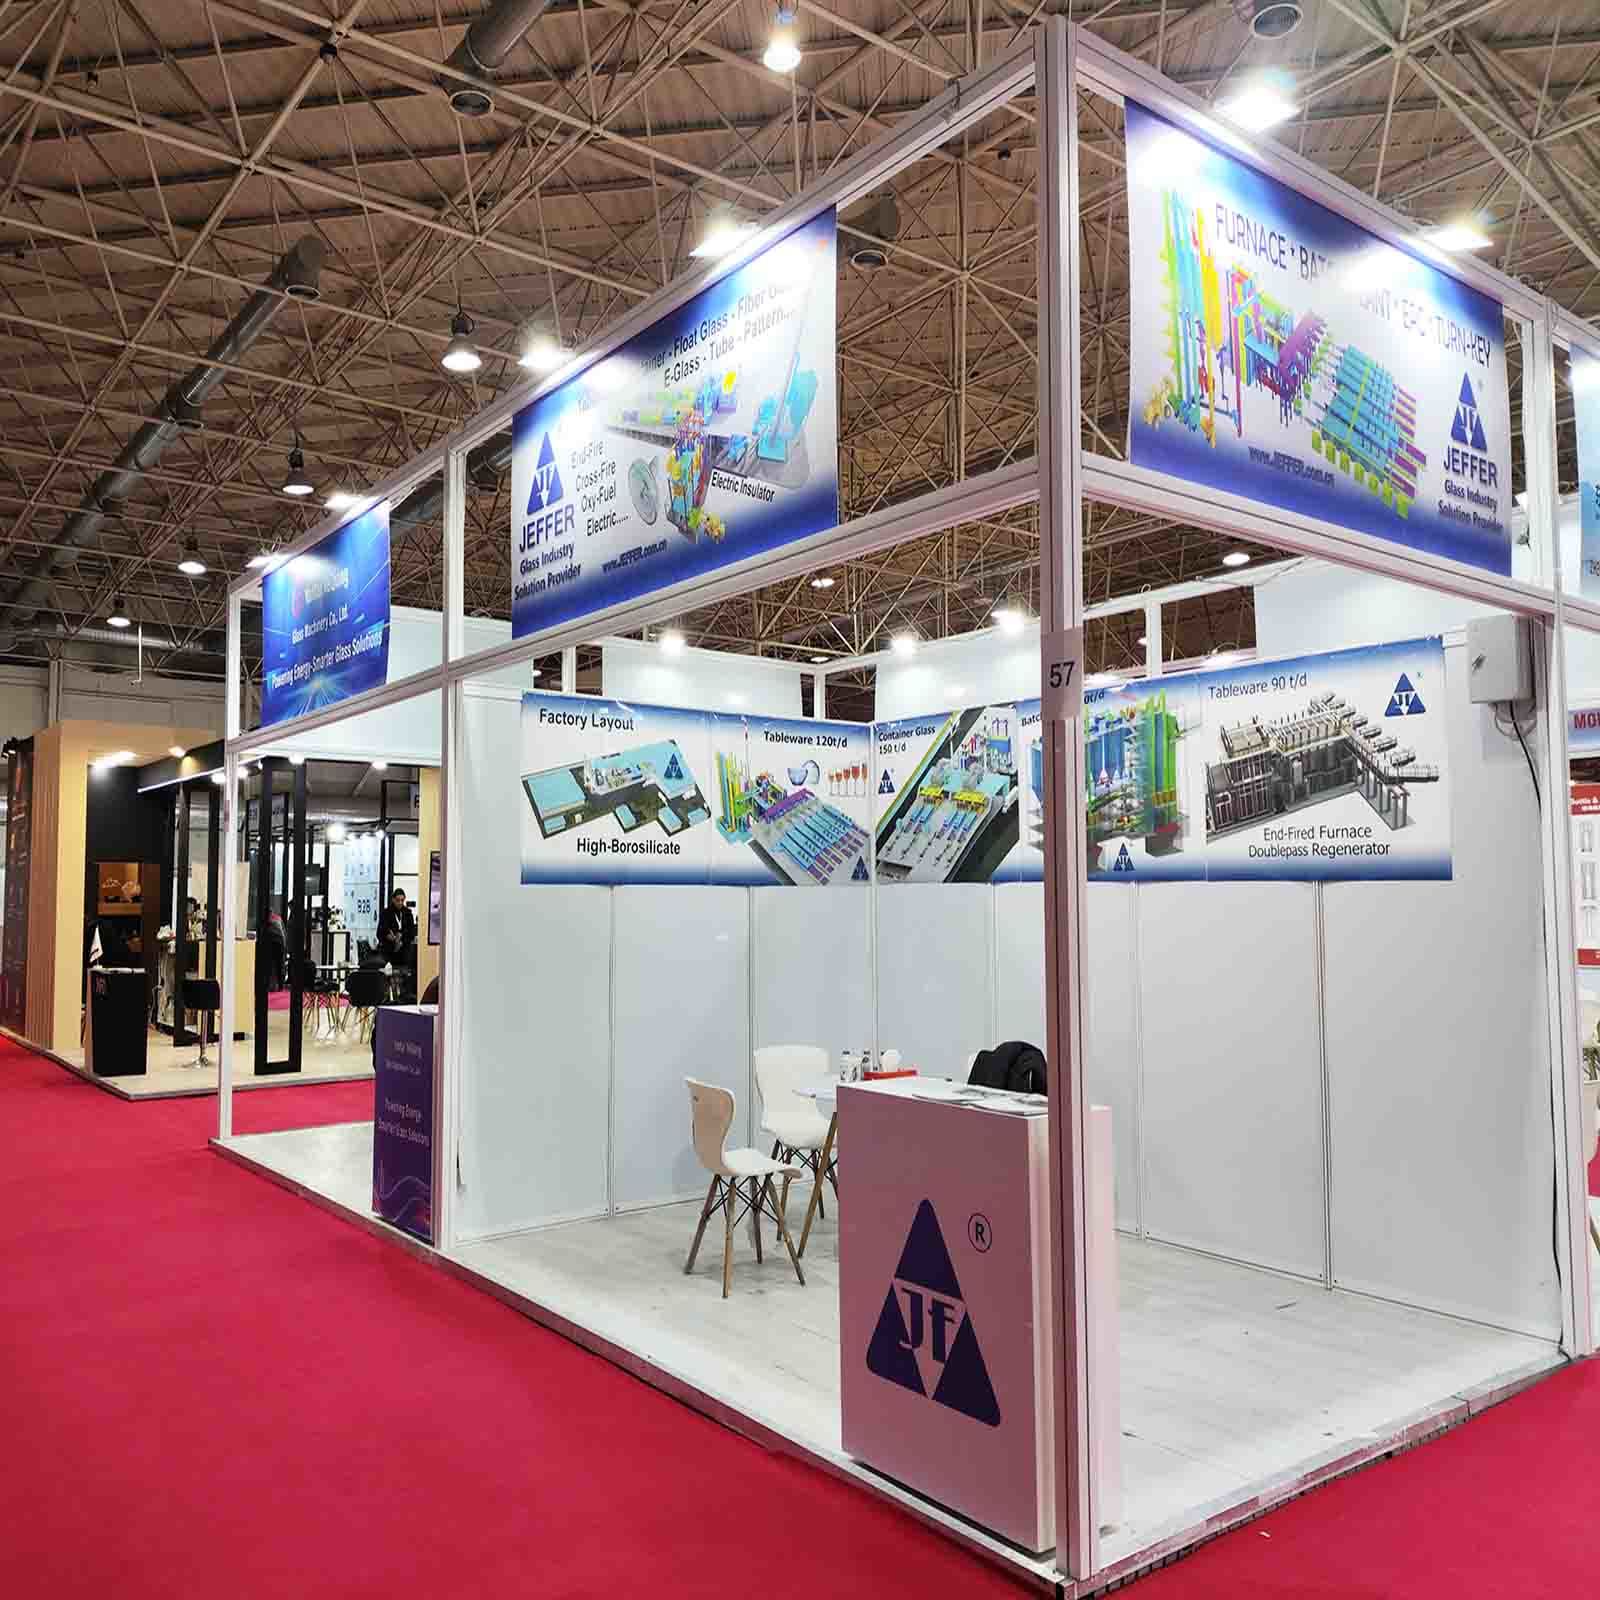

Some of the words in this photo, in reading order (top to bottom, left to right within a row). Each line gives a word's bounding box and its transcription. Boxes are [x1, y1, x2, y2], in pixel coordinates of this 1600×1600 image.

[1215, 203, 1287, 270] FURNACE
[673, 330, 698, 359] Float
[700, 313, 729, 341] Glass
[737, 288, 766, 319] Fiber
[664, 355, 700, 388] E-Glass
[709, 335, 735, 361] Tube
[576, 460, 616, 492] Cross-Fire
[1443, 446, 1499, 488] JEFFER
[581, 481, 616, 513] Oxy-Fuel
[711, 471, 740, 493] Electric
[740, 479, 775, 502] Insulator
[1444, 478, 1465, 498] Glass
[1466, 486, 1498, 512] Industry
[1438, 499, 1471, 522] Solution
[519, 504, 575, 552] JEFFER
[520, 554, 540, 575] Glass
[541, 542, 575, 566] Industry
[514, 575, 547, 600] Solution
[548, 562, 582, 586] Provider
[352, 631, 382, 656] Solutions
[1049, 661, 1075, 688] 57
[1207, 678, 1268, 700] Tableware
[1271, 675, 1286, 690] 90
[1289, 673, 1307, 689] t/d
[1084, 688, 1105, 704] 0t/d
[539, 708, 588, 730] Factory
[592, 711, 634, 731] Layout
[1022, 712, 1041, 727] Batc
[1574, 712, 1600, 729] MO
[764, 731, 813, 745] Tableware
[815, 736, 848, 749] 120t/d
[879, 728, 913, 742] Container
[915, 725, 936, 737] Glass
[879, 744, 893, 755] 150
[577, 837, 681, 856] High-Borosilicate
[1264, 826, 1315, 841] End-Fired
[1319, 825, 1372, 839] Furnace
[1248, 844, 1309, 859] Doublepass
[1311, 843, 1391, 860] Regenerator
